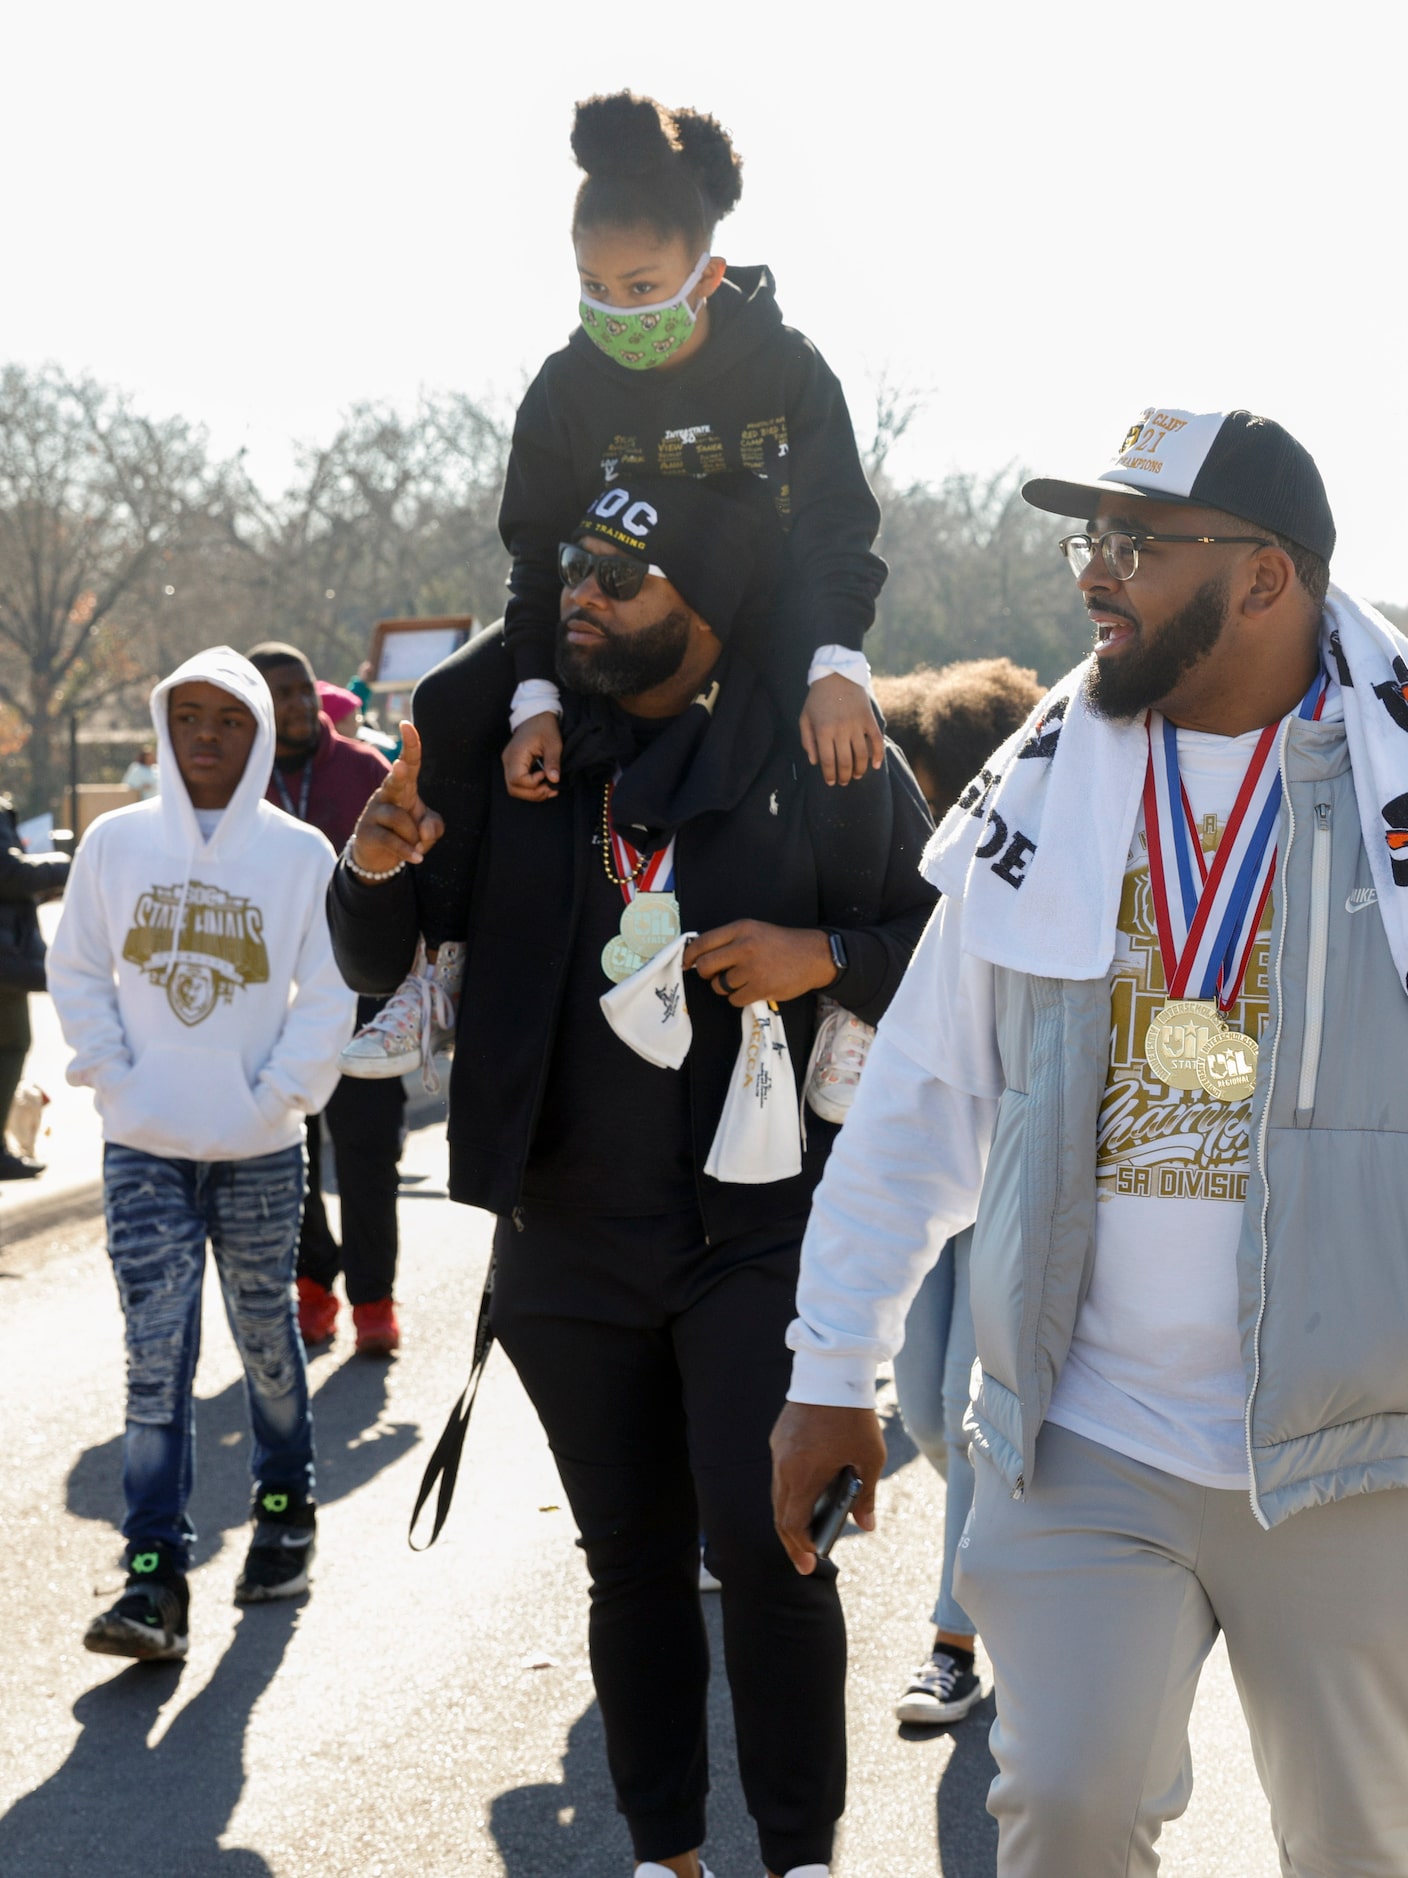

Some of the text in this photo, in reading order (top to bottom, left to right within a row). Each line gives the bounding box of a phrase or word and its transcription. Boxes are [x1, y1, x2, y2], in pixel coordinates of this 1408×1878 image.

[587, 487, 658, 537] OC
[594, 522, 647, 551] TRAINING
[1350, 887, 1378, 904] NIKE
[1171, 1059, 1199, 1071] STAT
